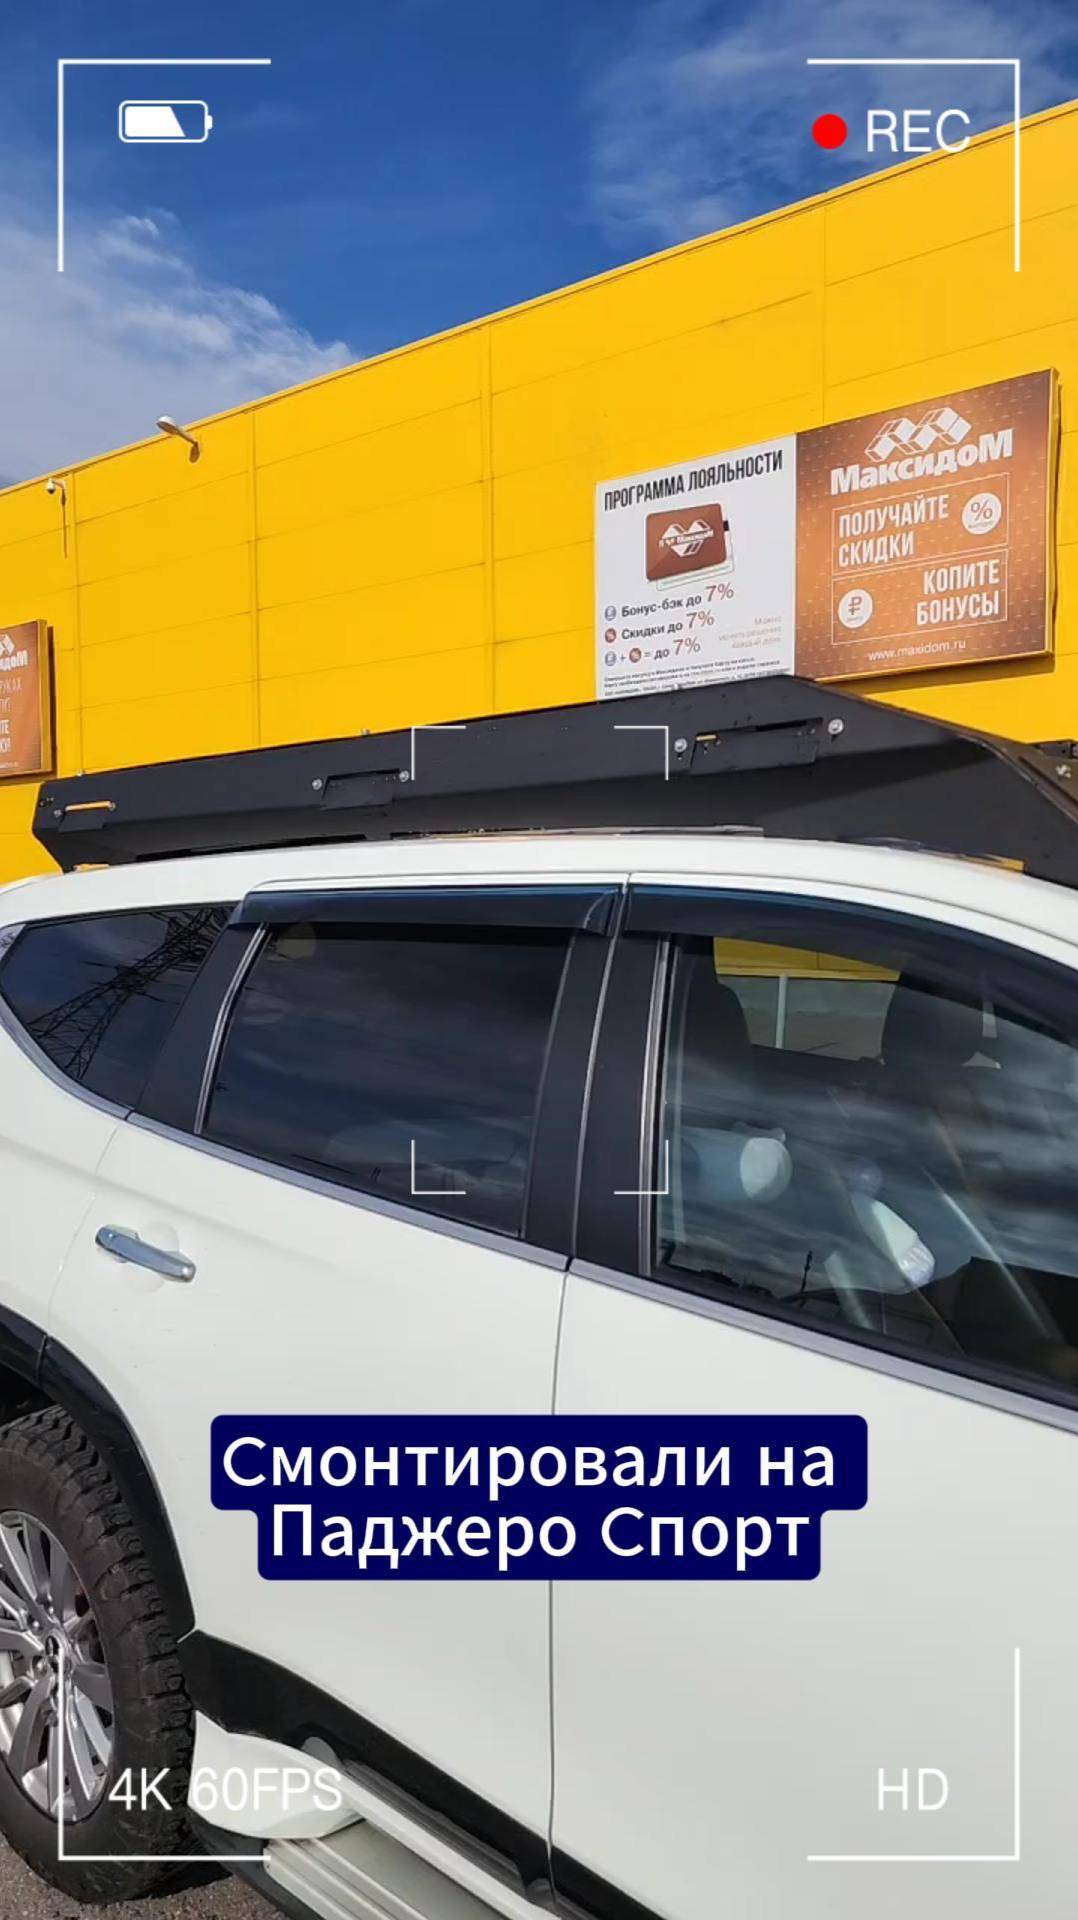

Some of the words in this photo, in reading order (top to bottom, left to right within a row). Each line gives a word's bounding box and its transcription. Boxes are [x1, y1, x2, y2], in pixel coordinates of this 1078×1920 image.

[604, 475, 684, 512] ПРОГРАММА
[688, 449, 783, 492] ЛОЯЛЬНОСТИ
[838, 493, 949, 539] ПОЛУЧАЙТЕ
[838, 531, 914, 568] СКИДКИ
[923, 558, 1000, 596] КОПИТЕ
[621, 598, 684, 618] Бонус-бэк
[686, 594, 702, 608] до
[706, 582, 734, 602] 7%
[916, 590, 999, 626] БОНУСЫ
[621, 624, 665, 641] Скидки
[667, 621, 683, 636] до
[686, 610, 714, 630] 7%
[653, 648, 670, 661] до
[673, 636, 701, 656] 7%
[867, 639, 966, 663] www.maxidom.ru
